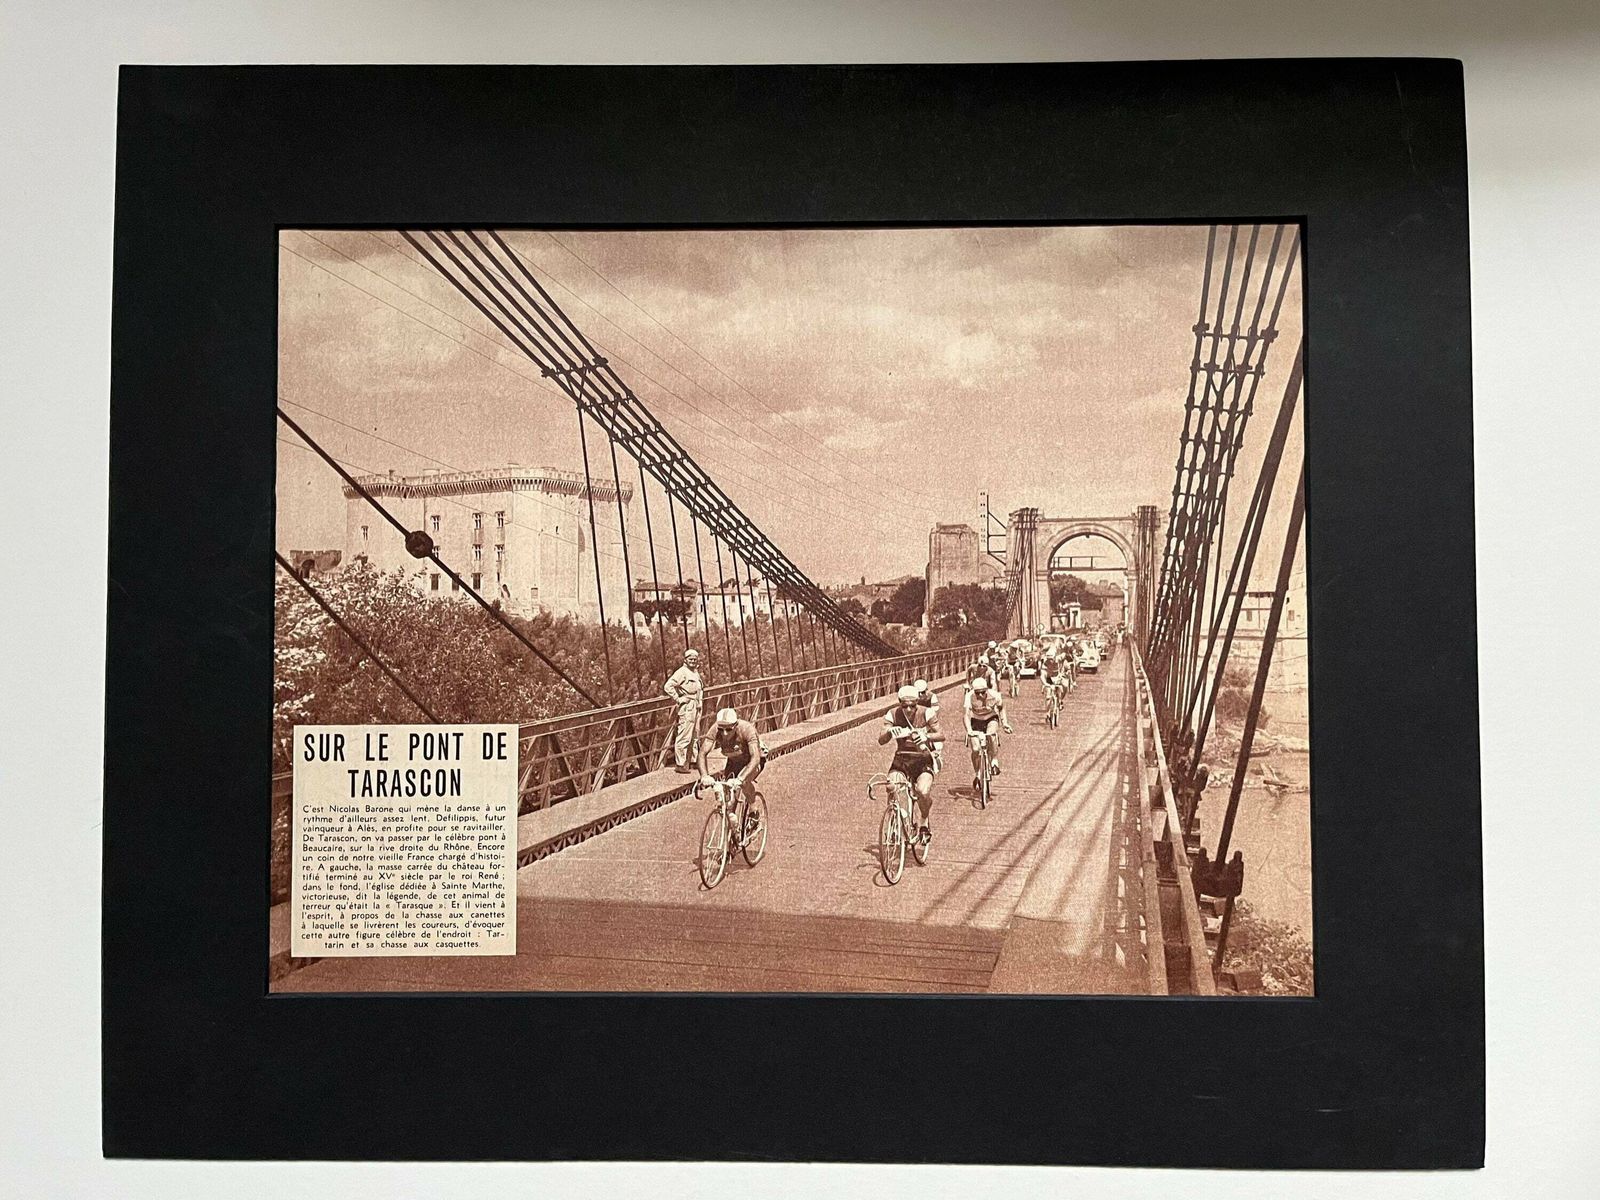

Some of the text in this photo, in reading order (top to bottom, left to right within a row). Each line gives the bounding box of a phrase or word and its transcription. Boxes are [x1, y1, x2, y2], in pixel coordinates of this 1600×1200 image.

[304, 732, 507, 761] SUR LE PONT DE
[348, 769, 461, 798] TARASCON
[302, 805, 324, 813] C'est
[329, 805, 360, 813] Nicolas
[365, 804, 394, 813] Barone
[398, 805, 411, 813] qui
[444, 804, 451, 812] la
[457, 804, 481, 812] danse
[485, 803, 490, 812] à
[303, 815, 333, 824] rythme
[339, 814, 377, 823] d'ailleurs
[485, 813, 506, 821] futur
[302, 825, 344, 834] vainqueur
[347, 824, 353, 832] à
[357, 824, 378, 833] Alès,
[395, 823, 423, 833] profite
[427, 825, 447, 833] pour
[302, 834, 315, 842] De
[318, 833, 358, 842] Tarascon,
[388, 835, 413, 843] passer
[417, 835, 430, 843] par
[434, 833, 442, 841] le
[445, 833, 475, 841] célèbre
[478, 834, 497, 842] pont
[501, 832, 506, 841] à
[302, 844, 346, 852] Beaucaire,
[367, 844, 374, 852] la
[379, 844, 395, 852] rive
[428, 843, 439, 851] du
[443, 842, 472, 851] Rhône.
[477, 842, 505, 850] Encore
[339, 853, 348, 861] de
[378, 853, 403, 861] vieille
[407, 852, 435, 861] France
[438, 853, 466, 862] chargé
[470, 852, 505, 860] d'histoi-
[318, 863, 325, 871] A
[329, 863, 361, 872] gauche,
[366, 863, 373, 871] la
[407, 863, 432, 871] carrée
[436, 862, 448, 870] du
[452, 862, 485, 870] château
[489, 862, 505, 870] for-
[302, 873, 320, 881] tifié
[400, 872, 424, 880] siècle
[428, 873, 442, 881] par
[448, 872, 455, 880] le
[478, 871, 499, 879] René
[302, 883, 321, 891] dans
[339, 882, 361, 891] fond,
[366, 882, 395, 892] l'église
[399, 882, 427, 890] dédiée
[432, 882, 436, 890] à
[441, 882, 467, 890] Sainte
[472, 882, 505, 890] Marthe,
[301, 893, 350, 901] victorieuse,
[356, 892, 367, 900] dit
[373, 892, 380, 900] la
[386, 892, 421, 901] légende,
[427, 892, 437, 900] de
[462, 891, 490, 899] animal
[495, 891, 505, 899] de
[335, 902, 368, 911] qu'était
[396, 901, 433, 910] Tarasque
[451, 901, 460, 909] Et
[465, 901, 470, 909] il
[475, 901, 496, 909] vient
[500, 900, 505, 908] à
[301, 912, 333, 921] l'esprit,
[340, 912, 345, 920] à
[351, 913, 379, 921] propos
[385, 911, 395, 919] de
[402, 911, 409, 919] la
[416, 911, 442, 919] chasse
[470, 911, 505, 919] canettes
[301, 922, 306, 930] à
[312, 921, 345, 931] laquelle
[364, 921, 399, 929] livrèrent
[405, 921, 416, 929] les
[464, 920, 505, 930] d'évoquer
[301, 932, 323, 940] cette
[355, 930, 380, 940] figure
[385, 930, 416, 939] célèbre
[421, 930, 431, 938] de
[436, 930, 471, 938] l'endroit
[486, 930, 505, 938] Tar-
[324, 941, 344, 949] tarin
[380, 940, 407, 948] chasse
